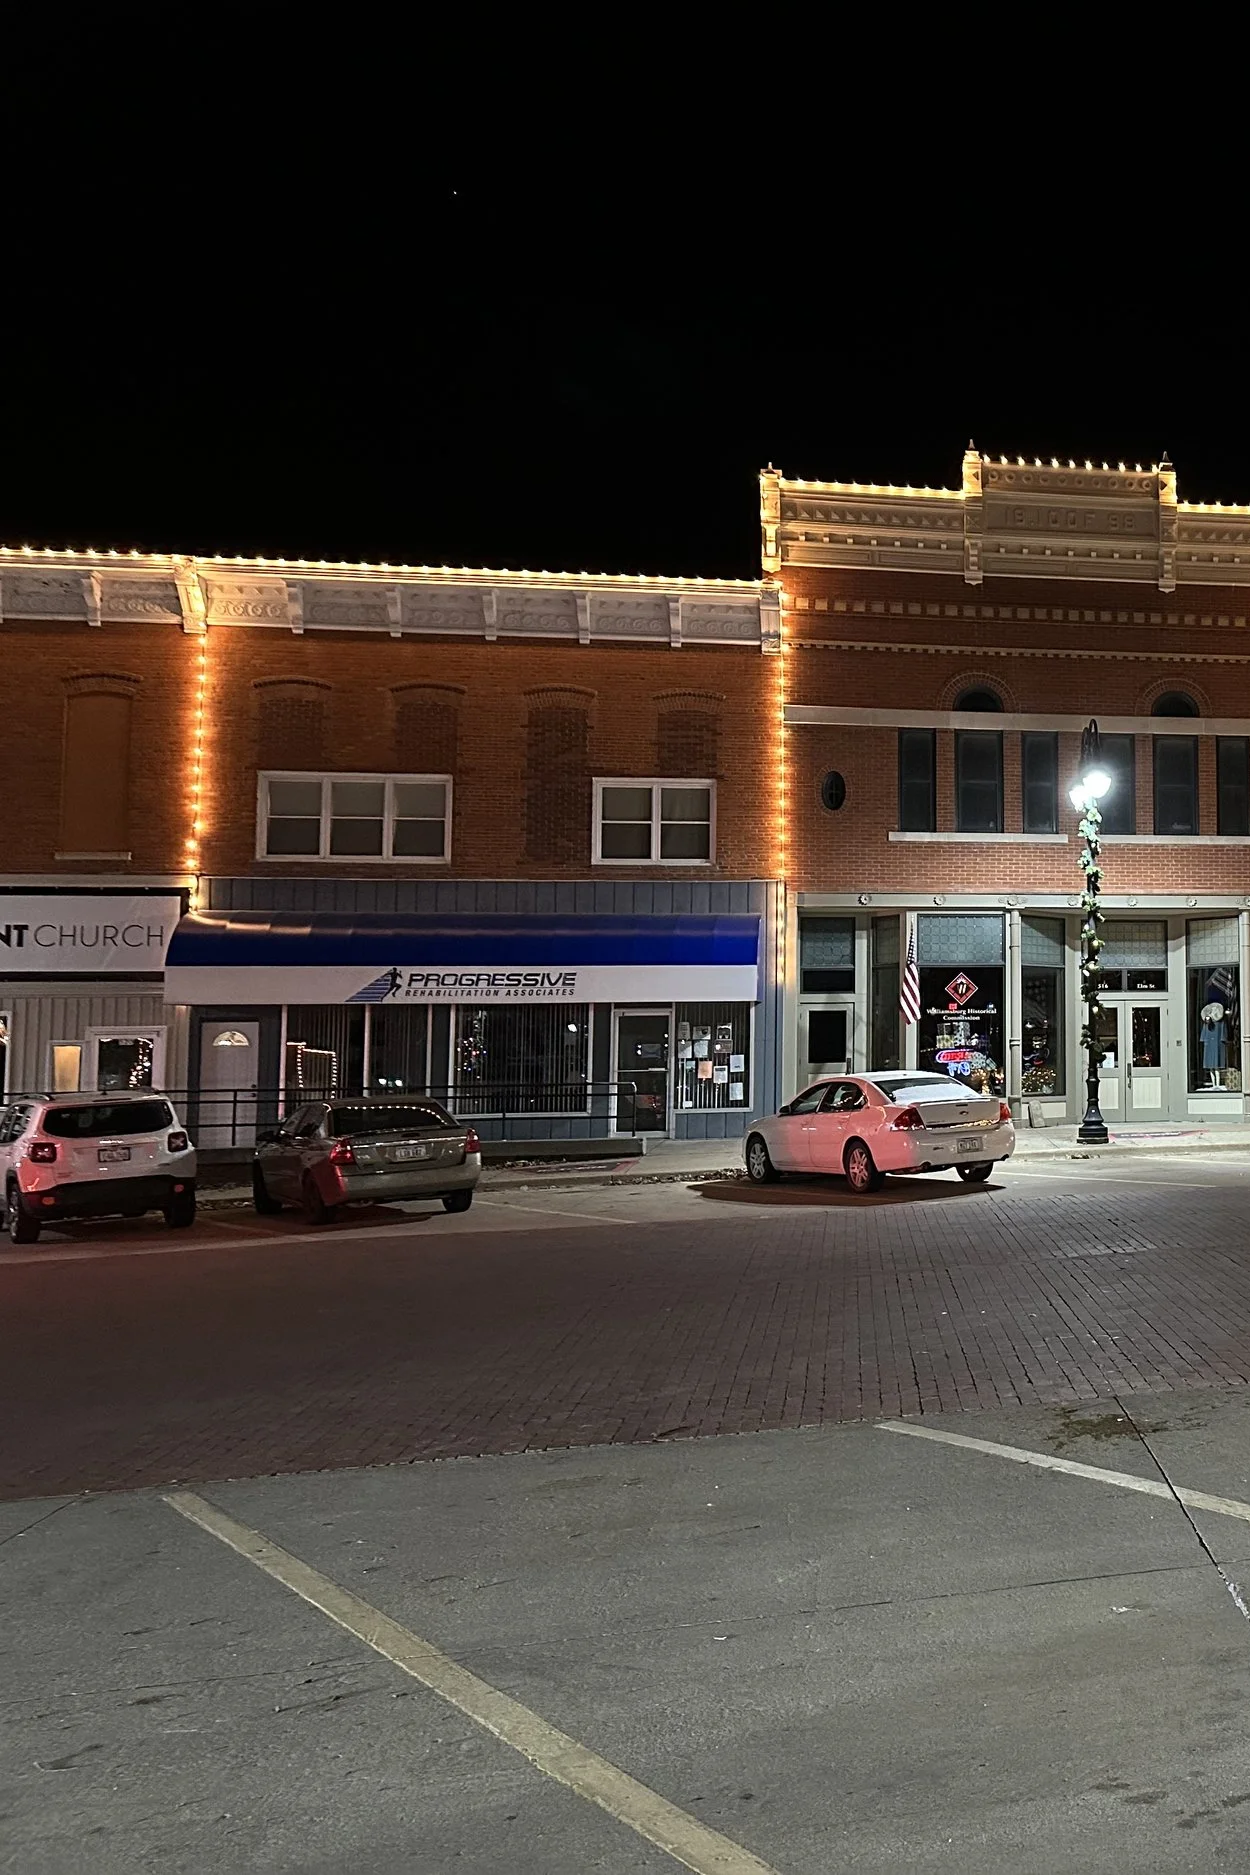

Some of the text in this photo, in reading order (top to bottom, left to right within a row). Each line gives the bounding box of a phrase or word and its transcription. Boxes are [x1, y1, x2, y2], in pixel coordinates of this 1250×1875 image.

[34, 924, 164, 948] CHURCH
[408, 972, 577, 987] PROGRESSIVE
[405, 988, 575, 997] REHABILITATION ASSOCIATES
